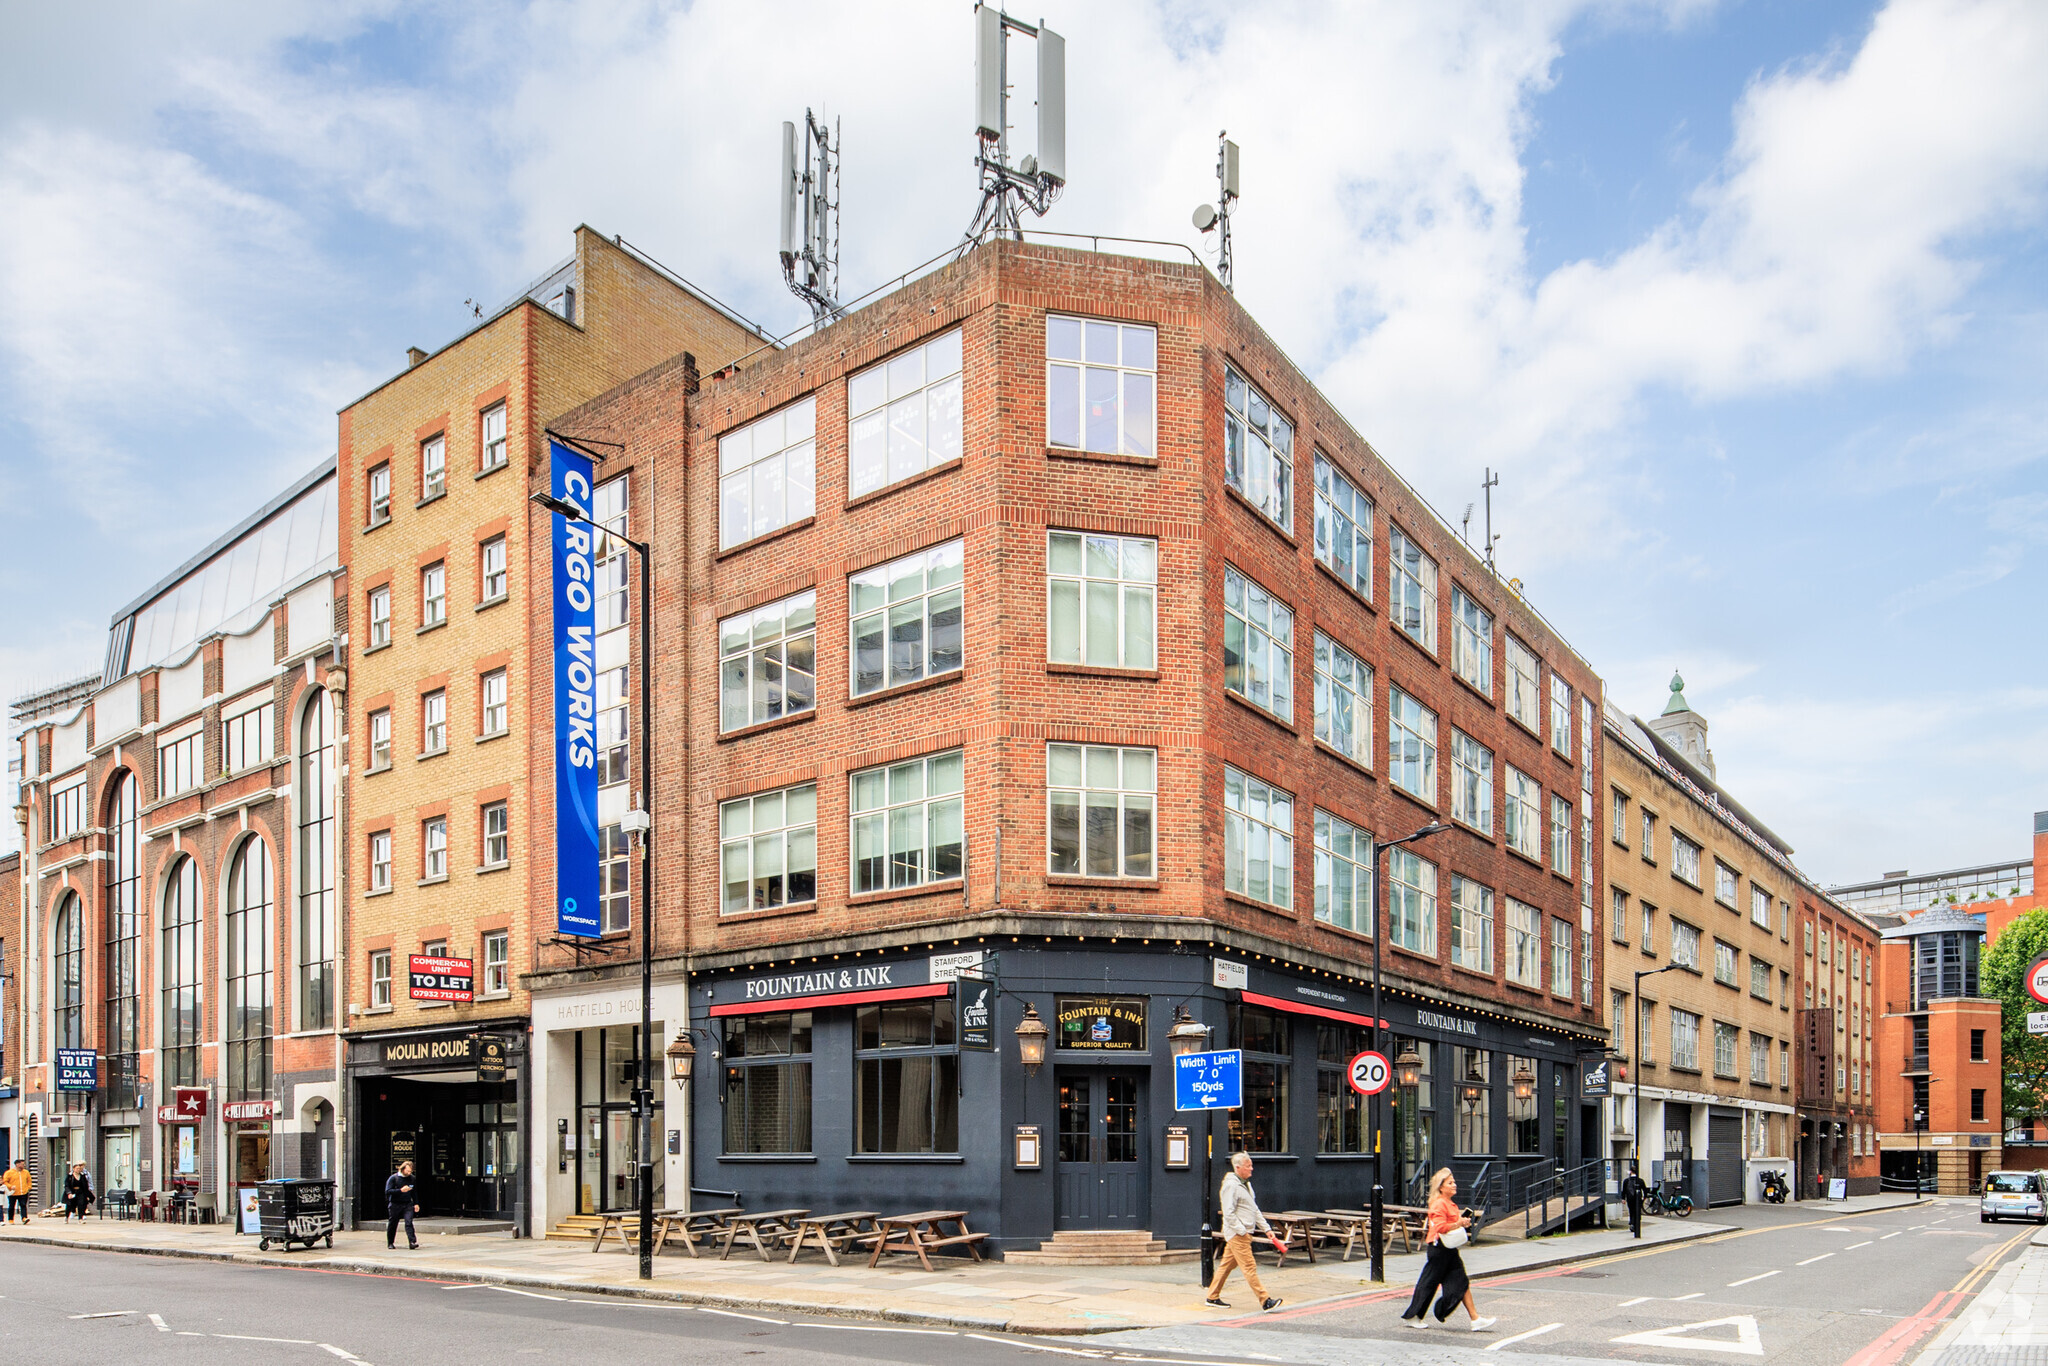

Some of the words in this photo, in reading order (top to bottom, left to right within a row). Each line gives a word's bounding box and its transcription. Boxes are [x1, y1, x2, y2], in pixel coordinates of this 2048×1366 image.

[564, 470, 591, 613] CARGO
[567, 625, 594, 770] WORKS
[562, 914, 597, 926] WORKSPACE
[412, 957, 470, 968] COMMERCIAL
[934, 955, 974, 966] STAMFORD
[431, 965, 452, 973] UNIT
[964, 967, 977, 976] SE1
[1217, 961, 1245, 975] HATFIELDS
[412, 974, 437, 988] TO
[440, 976, 470, 989] LET
[745, 974, 835, 998] FOUNTAIN
[839, 969, 853, 989] &
[856, 965, 892, 987] INK
[1218, 973, 1228, 982] SE1
[413, 990, 439, 998] 07932
[440, 991, 454, 999] 712
[557, 1002, 613, 1019] HATFIELD
[619, 997, 656, 1013] HOUE
[964, 1016, 973, 1027] &
[973, 1016, 988, 1026] INK
[1058, 1006, 1112, 1024] FOUNTAIN
[1114, 1008, 1122, 1018] &
[1124, 1010, 1144, 1026] INK
[1417, 1009, 1456, 1031] FOUNTAIN
[1456, 1018, 1463, 1032] &
[1463, 1019, 1477, 1036] INK
[386, 1042, 429, 1061] MOULIN
[431, 1039, 470, 1059] ROUDE
[60, 1056, 75, 1067] TO
[75, 1056, 95, 1067] LET
[1180, 1057, 1207, 1069] Width
[1213, 1054, 1236, 1066] Limit
[63, 1069, 92, 1078] DMA
[1355, 1064, 1385, 1082] 20
[1191, 1081, 1224, 1094] 150yds
[1592, 1077, 1606, 1085] INK
